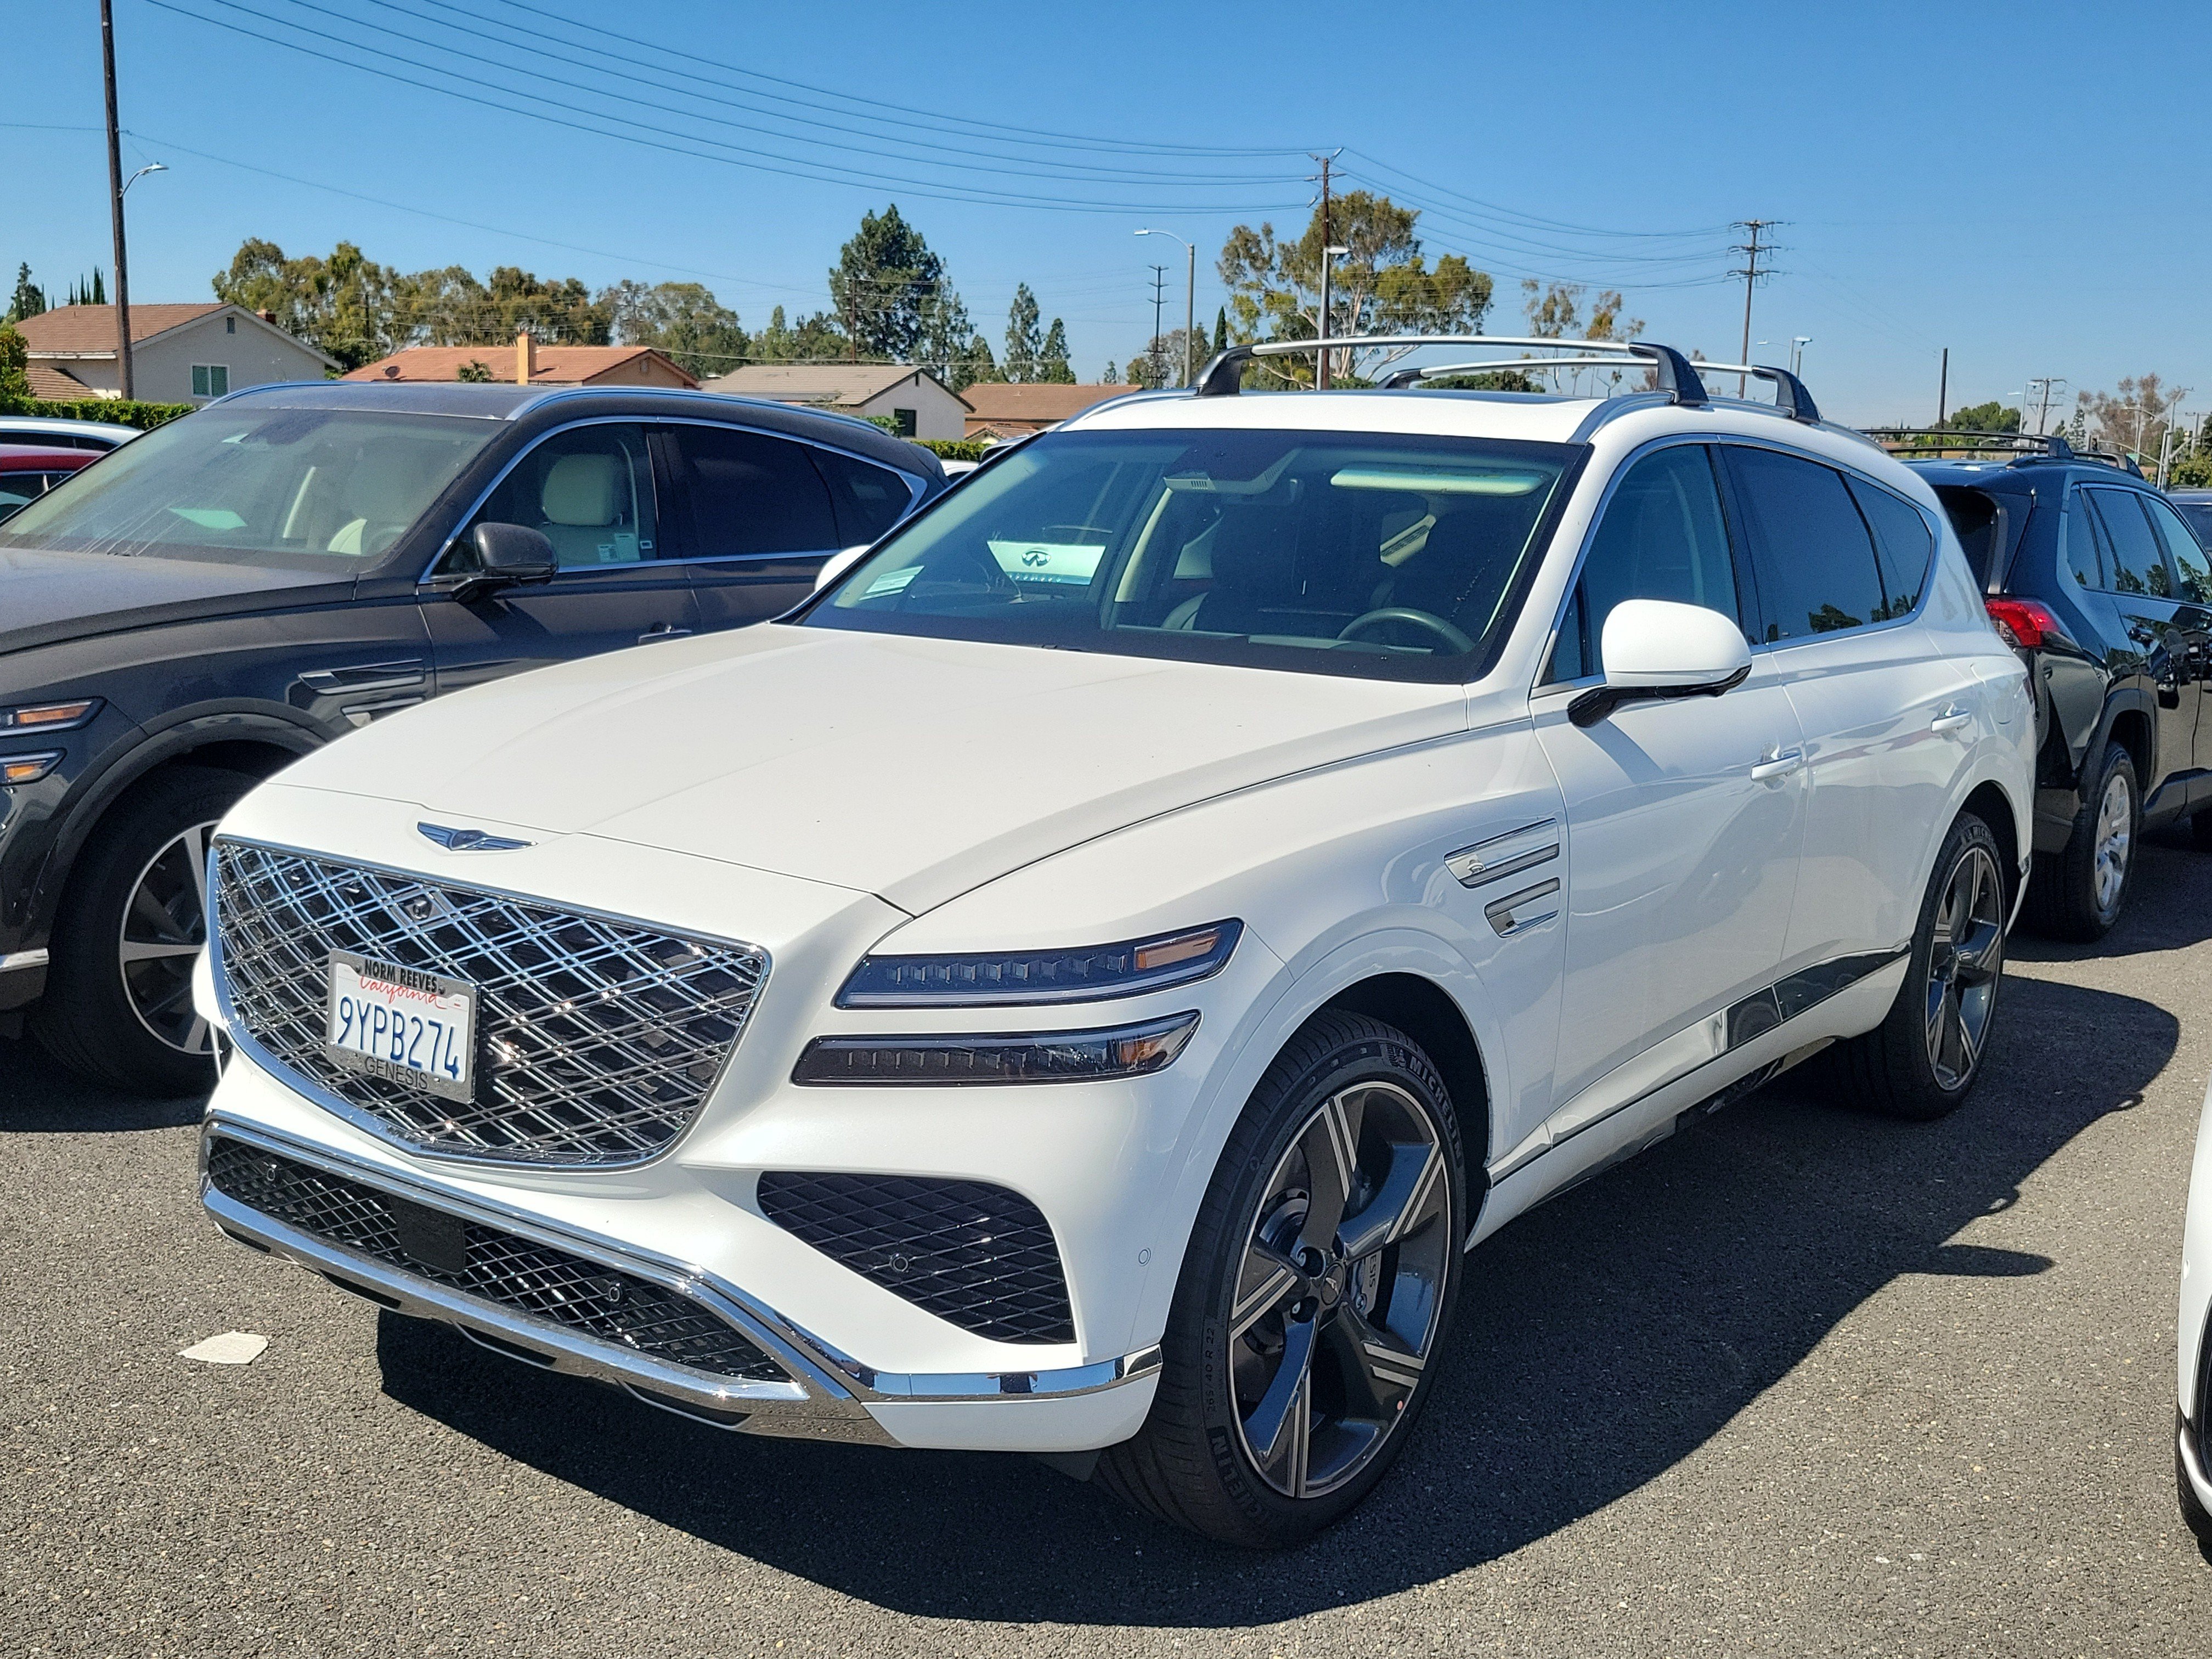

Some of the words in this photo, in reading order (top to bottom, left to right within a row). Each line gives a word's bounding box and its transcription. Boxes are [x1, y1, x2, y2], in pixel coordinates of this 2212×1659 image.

[365, 960, 396, 983] NORM
[400, 968, 438, 994] REEVES
[338, 996, 460, 1080] 9YPB274
[364, 1056, 428, 1090] GENESIS
[1409, 1055, 1462, 1160] MICHELIN
